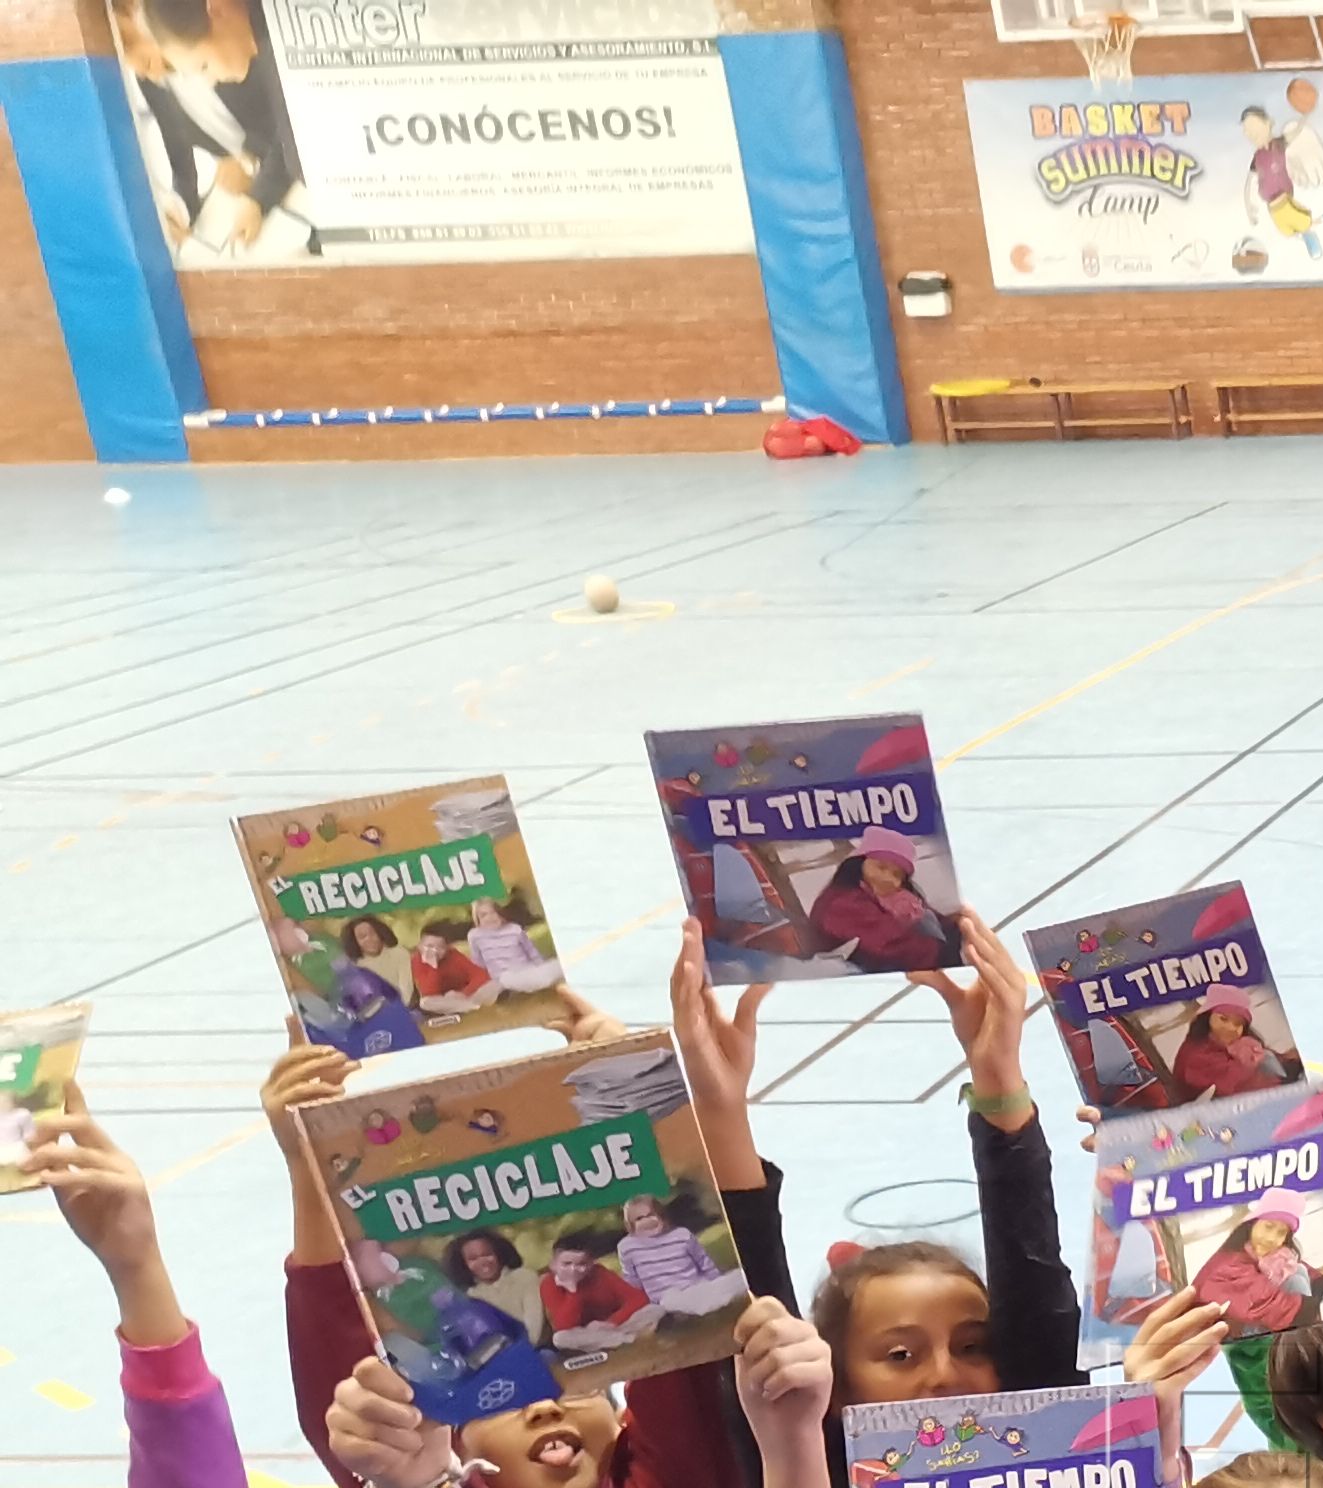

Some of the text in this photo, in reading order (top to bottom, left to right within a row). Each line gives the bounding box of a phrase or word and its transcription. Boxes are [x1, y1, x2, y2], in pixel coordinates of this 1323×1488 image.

[362, 104, 677, 155] ¡CONÓCENOS!
[1029, 100, 1192, 140] BASKET
[1036, 136, 1200, 195] summer
[709, 782, 919, 838] EL TIEMPO
[267, 849, 486, 916] EL RECICLAJE
[1079, 979, 1130, 1016] EL
[1120, 941, 1250, 1002] TIEMPO
[341, 1131, 642, 1233] EL RECICLAJE
[1128, 1177, 1178, 1218] EL
[1191, 1141, 1320, 1202] TIEMPO
